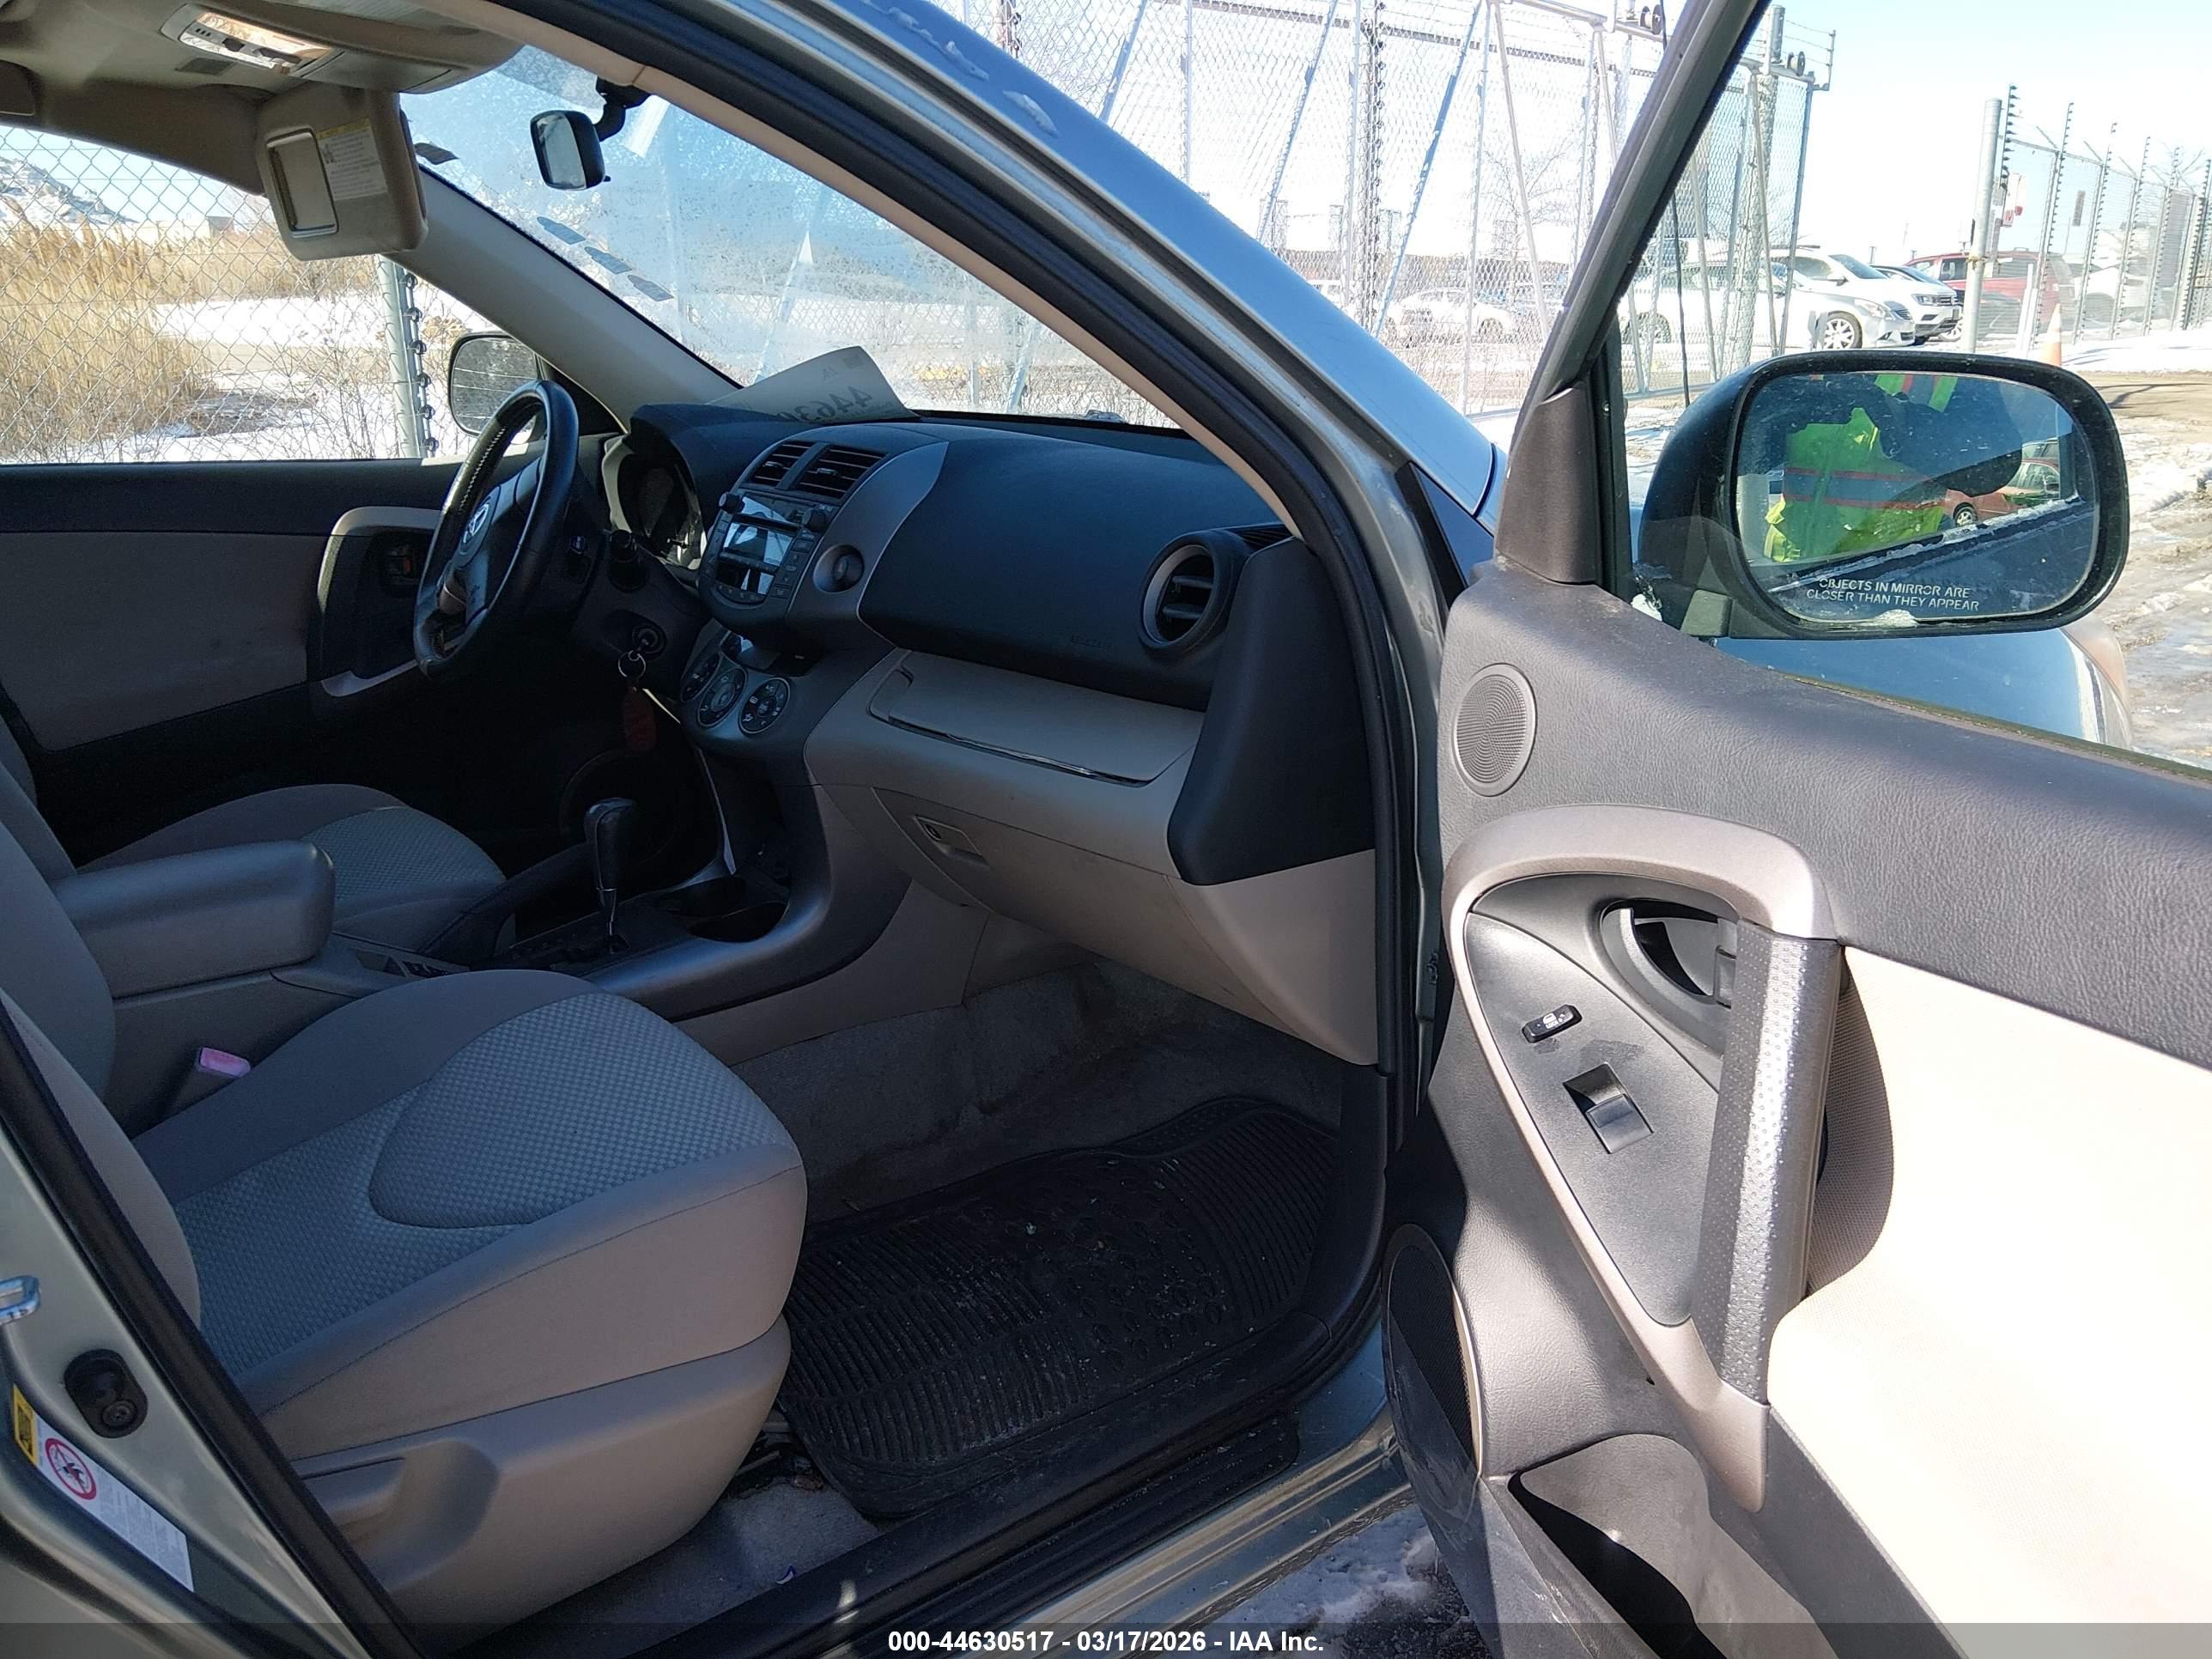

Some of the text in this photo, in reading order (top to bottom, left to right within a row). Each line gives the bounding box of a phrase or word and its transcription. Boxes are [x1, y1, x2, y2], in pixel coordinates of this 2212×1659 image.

[1806, 588, 1979, 611] CLOSER THAN THEY APPEAR
[1819, 578, 1971, 599] OBJECTS IN MIRROR ARE
